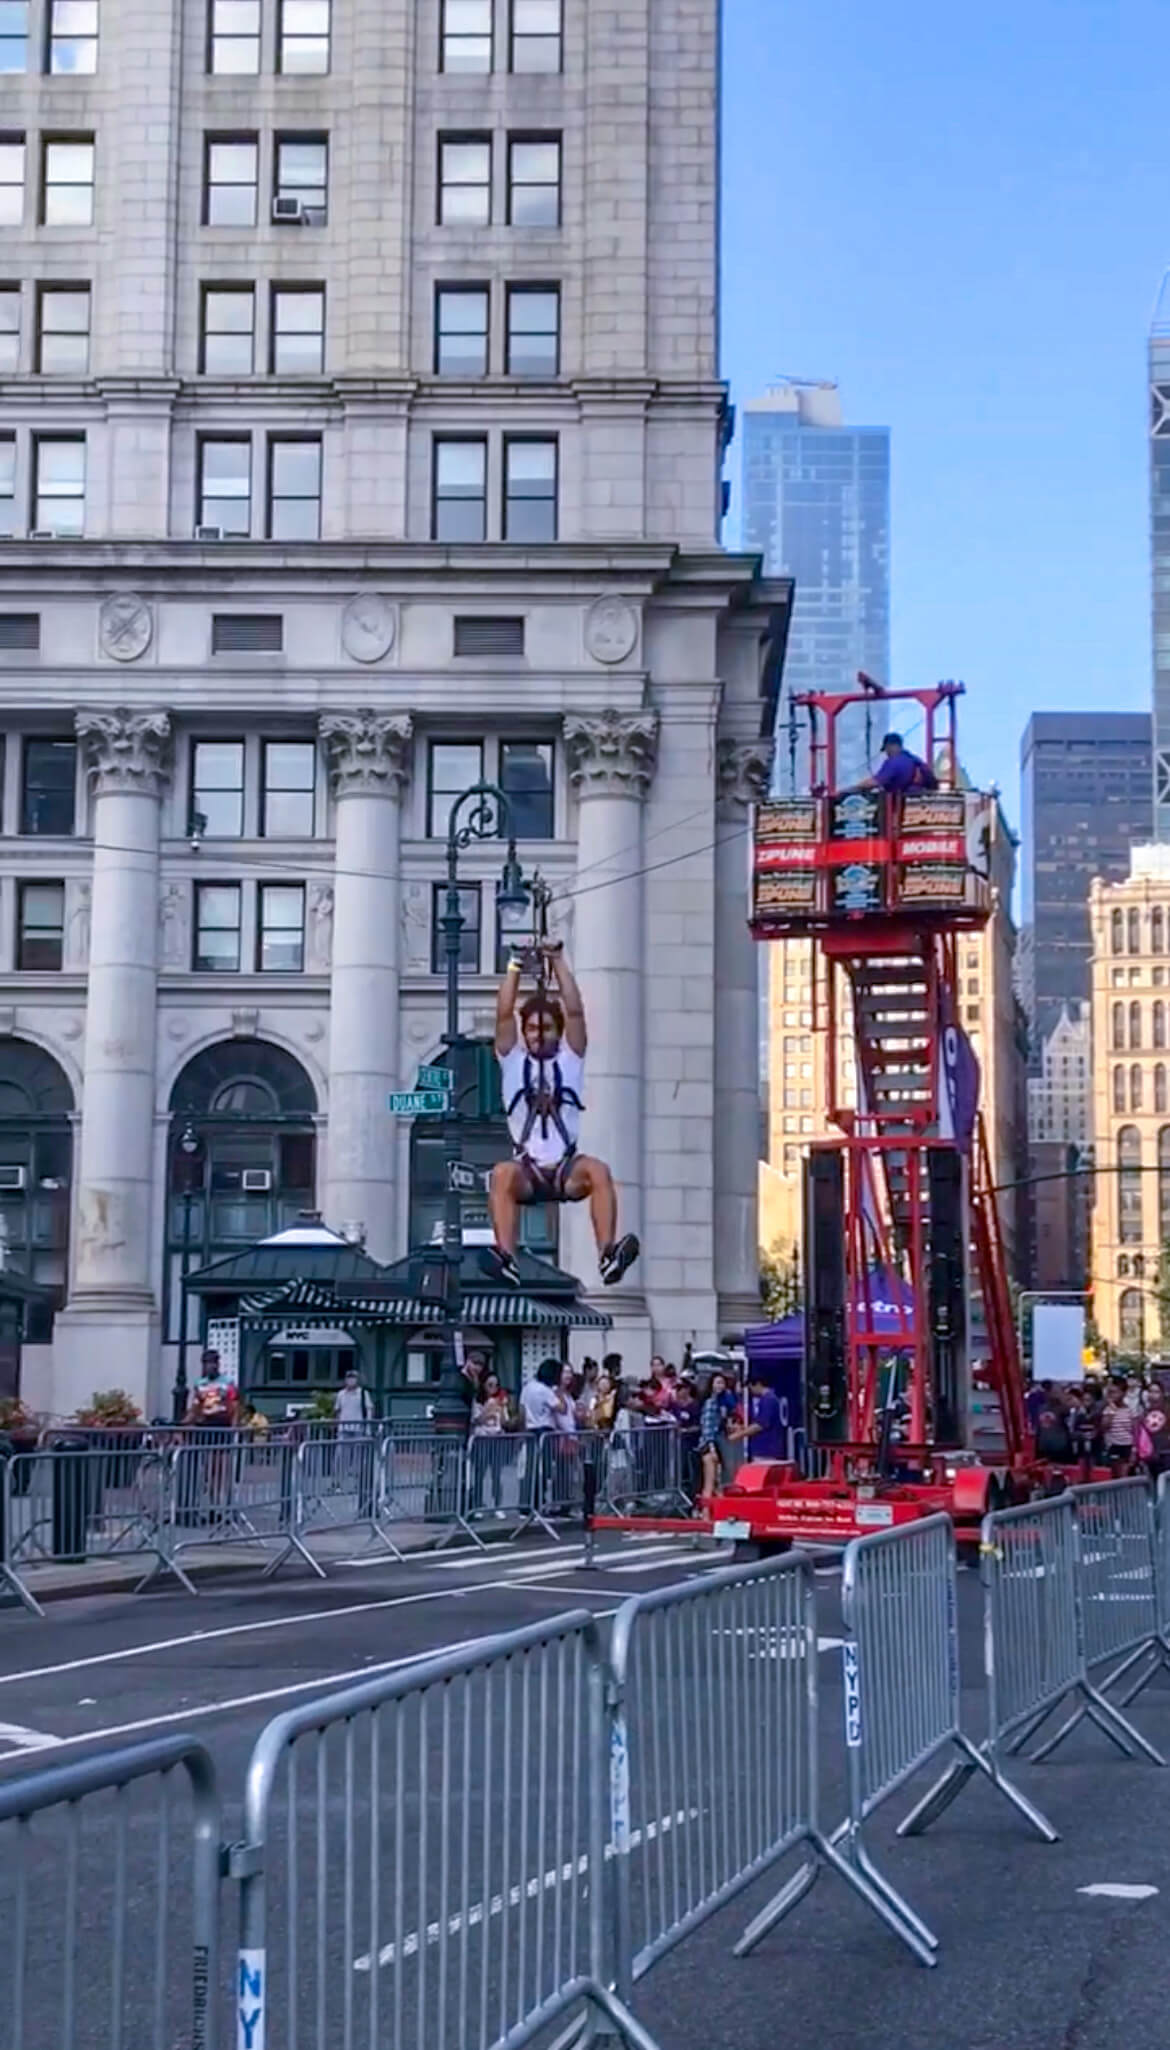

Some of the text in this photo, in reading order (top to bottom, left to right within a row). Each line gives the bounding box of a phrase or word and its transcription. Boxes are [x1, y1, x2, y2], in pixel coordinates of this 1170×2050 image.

[902, 840, 958, 856] MOBILE
[392, 1095, 425, 1111] DUANE
[286, 1330, 310, 1340] NYC
[845, 1645, 860, 1741] NYPD
